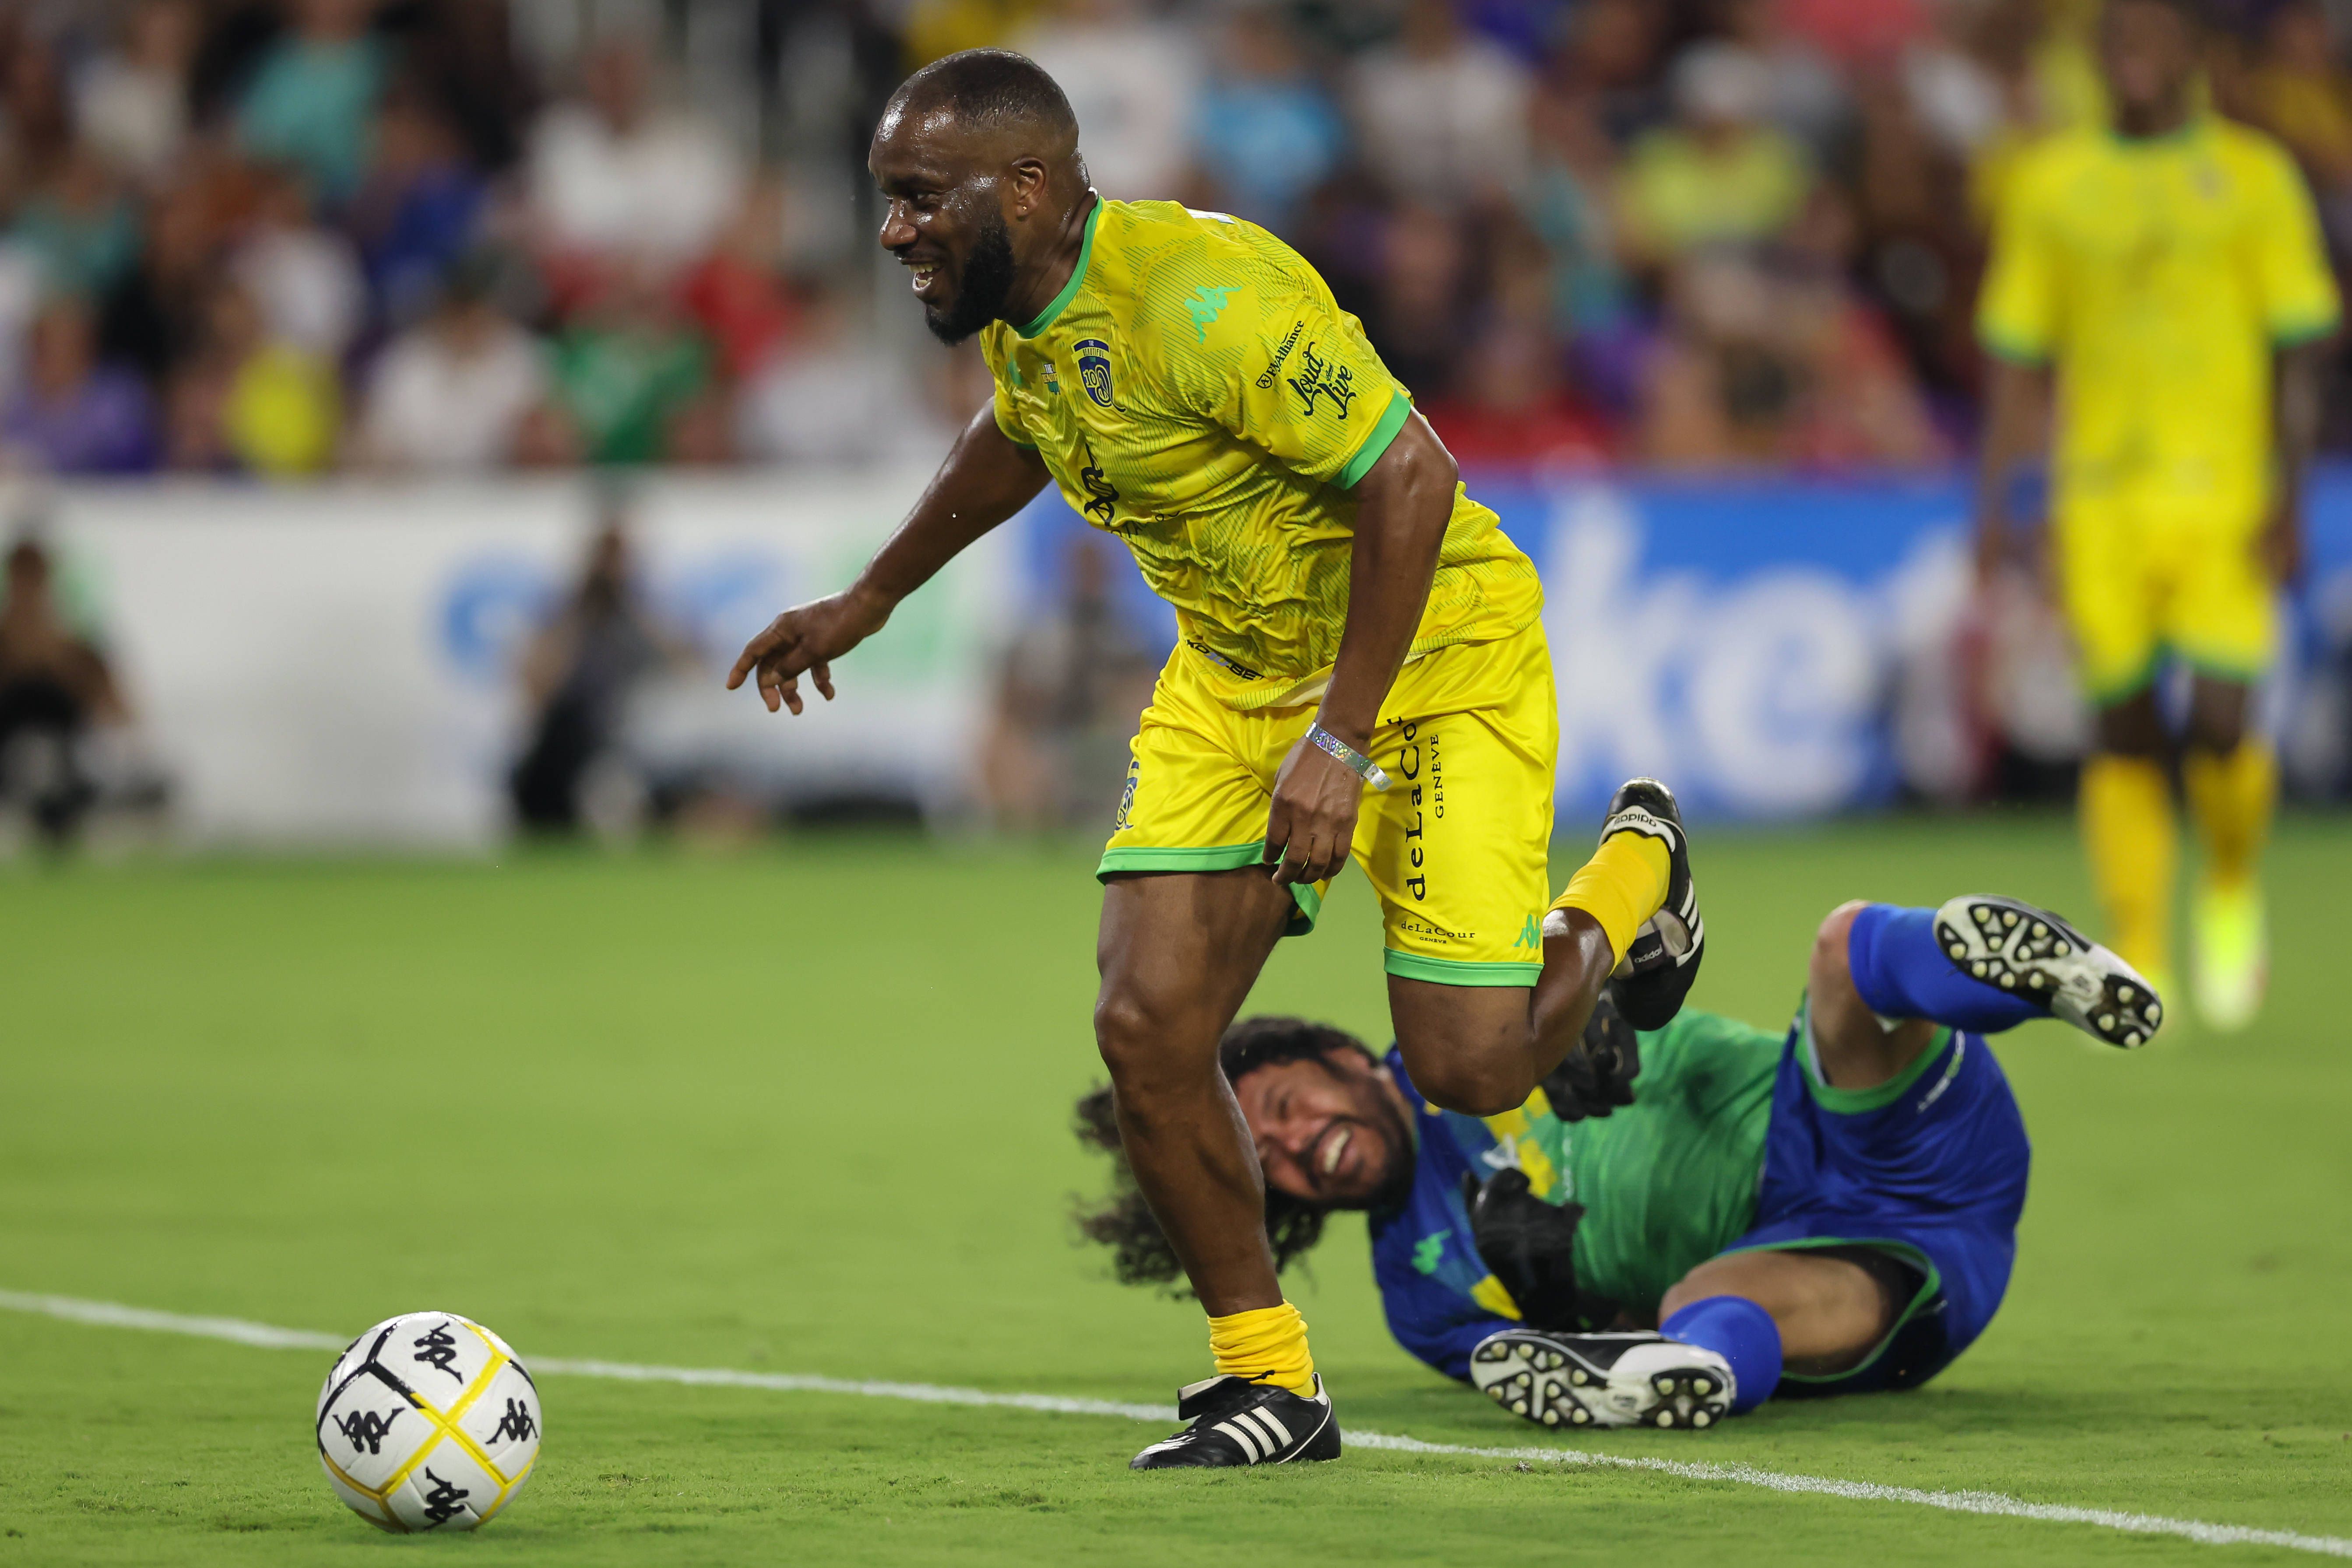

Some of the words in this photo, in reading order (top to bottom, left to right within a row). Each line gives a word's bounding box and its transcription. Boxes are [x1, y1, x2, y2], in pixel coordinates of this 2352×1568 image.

[1266, 320, 1304, 377] FlyAlliance
[1287, 341, 1324, 416] Loud
[1317, 365, 1357, 420] Live
[1386, 716, 1426, 901] deLaCo
[1401, 921, 1476, 938] deLaCour
